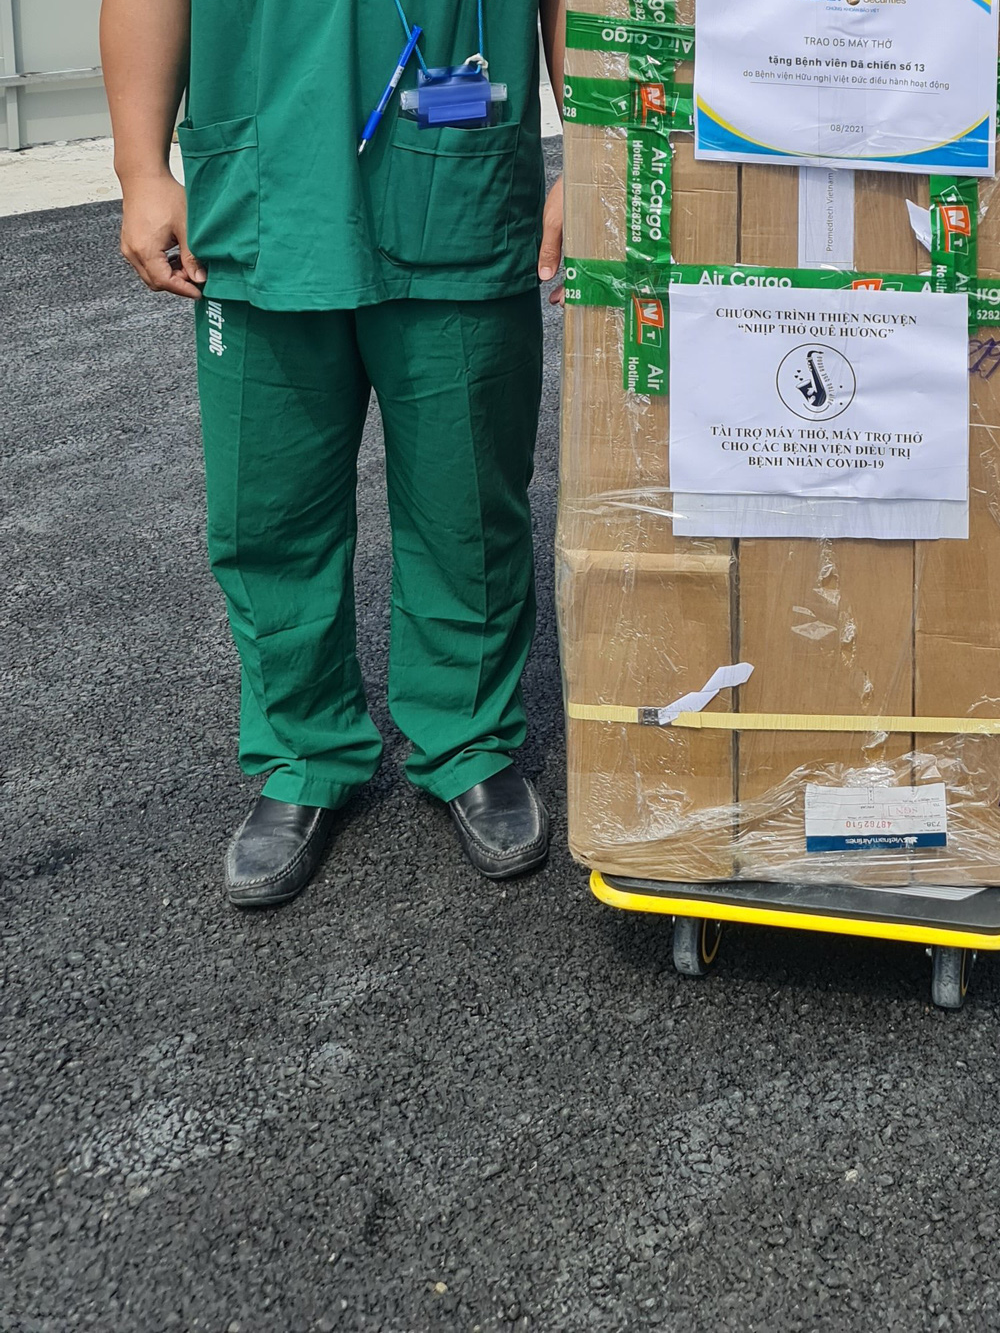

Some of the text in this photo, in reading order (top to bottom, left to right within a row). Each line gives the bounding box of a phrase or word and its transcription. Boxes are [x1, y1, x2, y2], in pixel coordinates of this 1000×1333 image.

[804, 36, 830, 47] TRAO
[832, 38, 846, 47] 05
[848, 37, 870, 48] MÁY
[769, 55, 792, 67] tặng
[795, 57, 822, 67] Bệnh
[867, 60, 897, 70] chiến
[899, 61, 912, 71] số
[914, 63, 925, 72] 13
[755, 70, 775, 79] Bệnh
[776, 70, 794, 80] viện
[795, 72, 812, 81] Hữu
[813, 74, 832, 84] nghị
[833, 74, 849, 84] Việt
[851, 75, 868, 84] Đức
[889, 77, 909, 86] hành
[910, 79, 928, 88] hoạt
[929, 80, 950, 90] động
[830, 123, 865, 133] 08/2021
[632, 140, 643, 176] Hotline
[646, 147, 667, 241] Air Cargo
[825, 172, 834, 252] Promedtech Vietnam
[698, 270, 792, 287] Air Cargo
[716, 307, 917, 327] CHƯƠNG TRÌNH THIỆN NGUYỆN
[778, 323, 806, 335] THỞ
[809, 324, 836, 337] QUÊ
[647, 363, 664, 391] Air
[710, 424, 731, 437] TÀI
[735, 427, 763, 440] TRỢ
[765, 425, 795, 438] MÁY
[832, 428, 861, 441] MÁY
[864, 431, 892, 445] TRỢ
[894, 431, 923, 444] THỞ
[721, 441, 749, 452] CHO
[752, 439, 780, 452] CÁC
[783, 442, 817, 455] BỆNH
[821, 443, 852, 456] VIỆN
[889, 447, 911, 460] TRỊ
[748, 454, 885, 469] BỆNH NHÂN COVID-19
